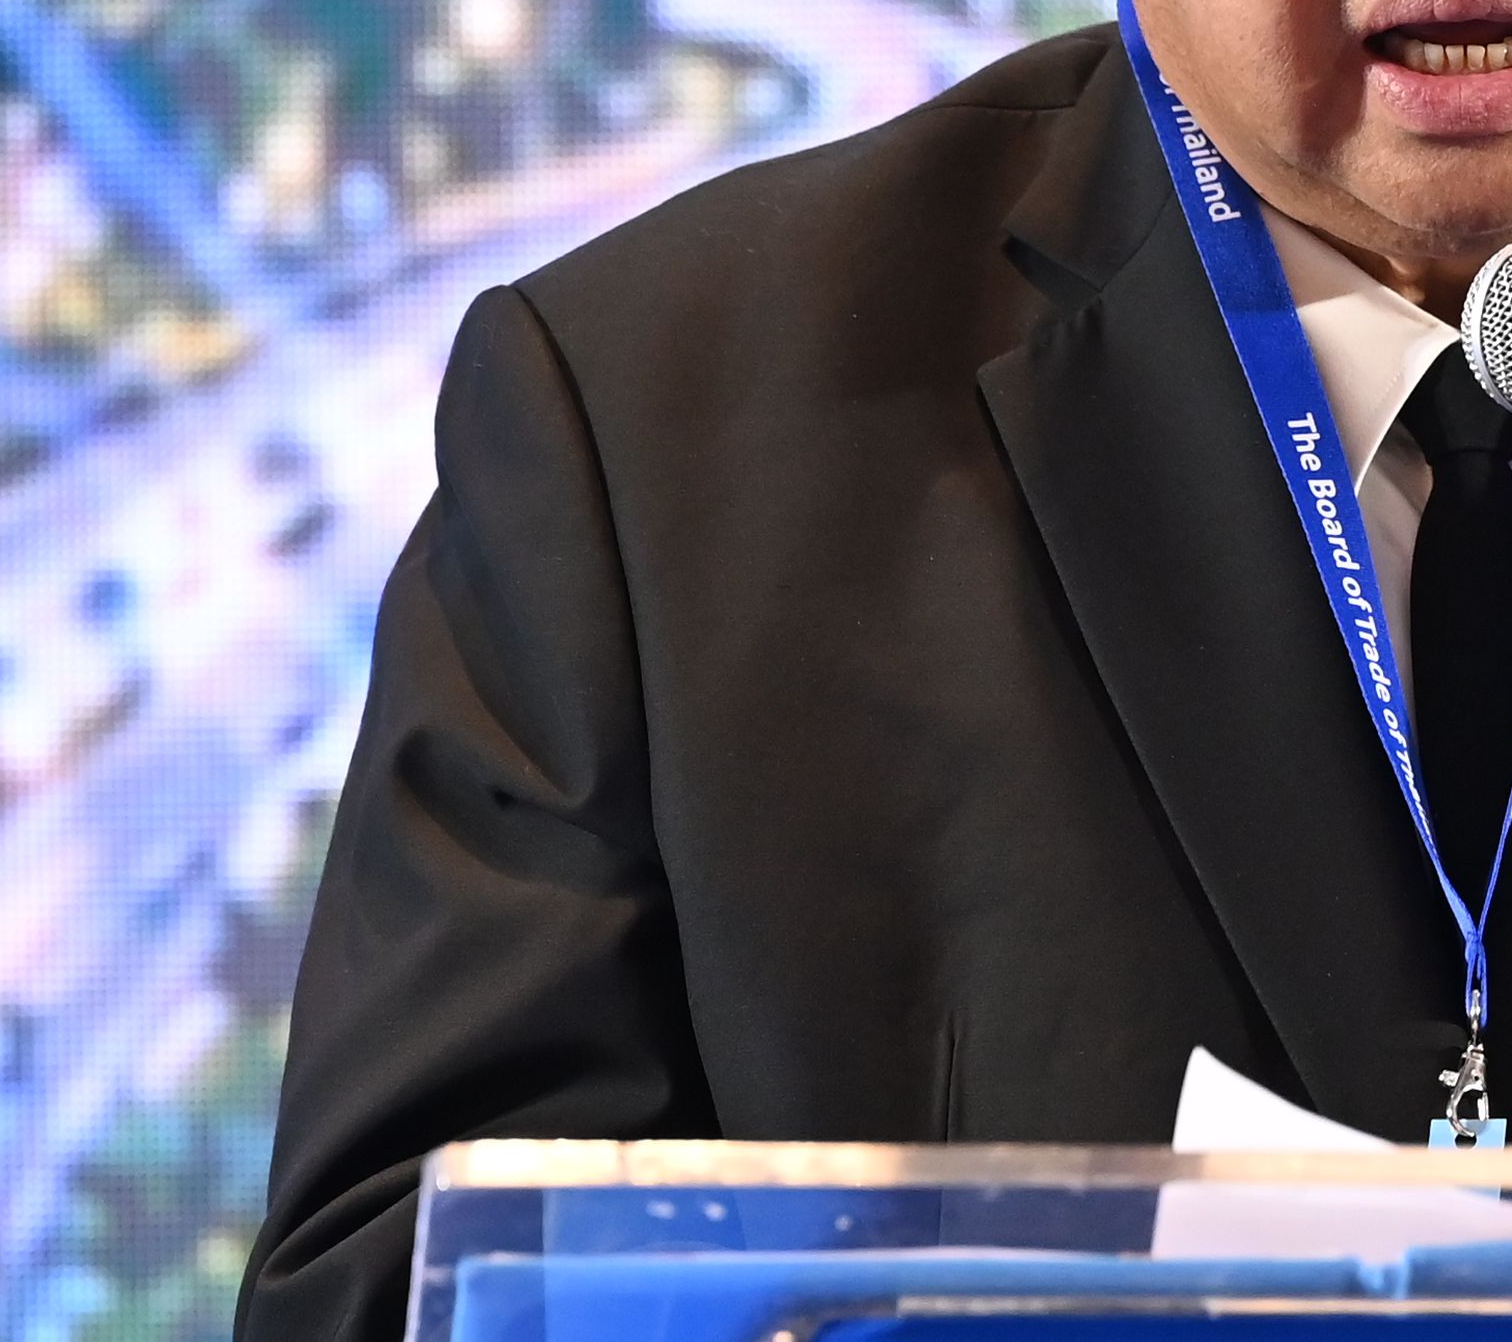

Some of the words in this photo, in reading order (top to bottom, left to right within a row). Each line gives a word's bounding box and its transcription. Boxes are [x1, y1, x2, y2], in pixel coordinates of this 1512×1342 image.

[1287, 412, 1321, 472] The
[1308, 478, 1361, 571] Board
[1342, 576, 1373, 617] of
[1354, 615, 1392, 703] Trade
[1383, 708, 1408, 749] of
